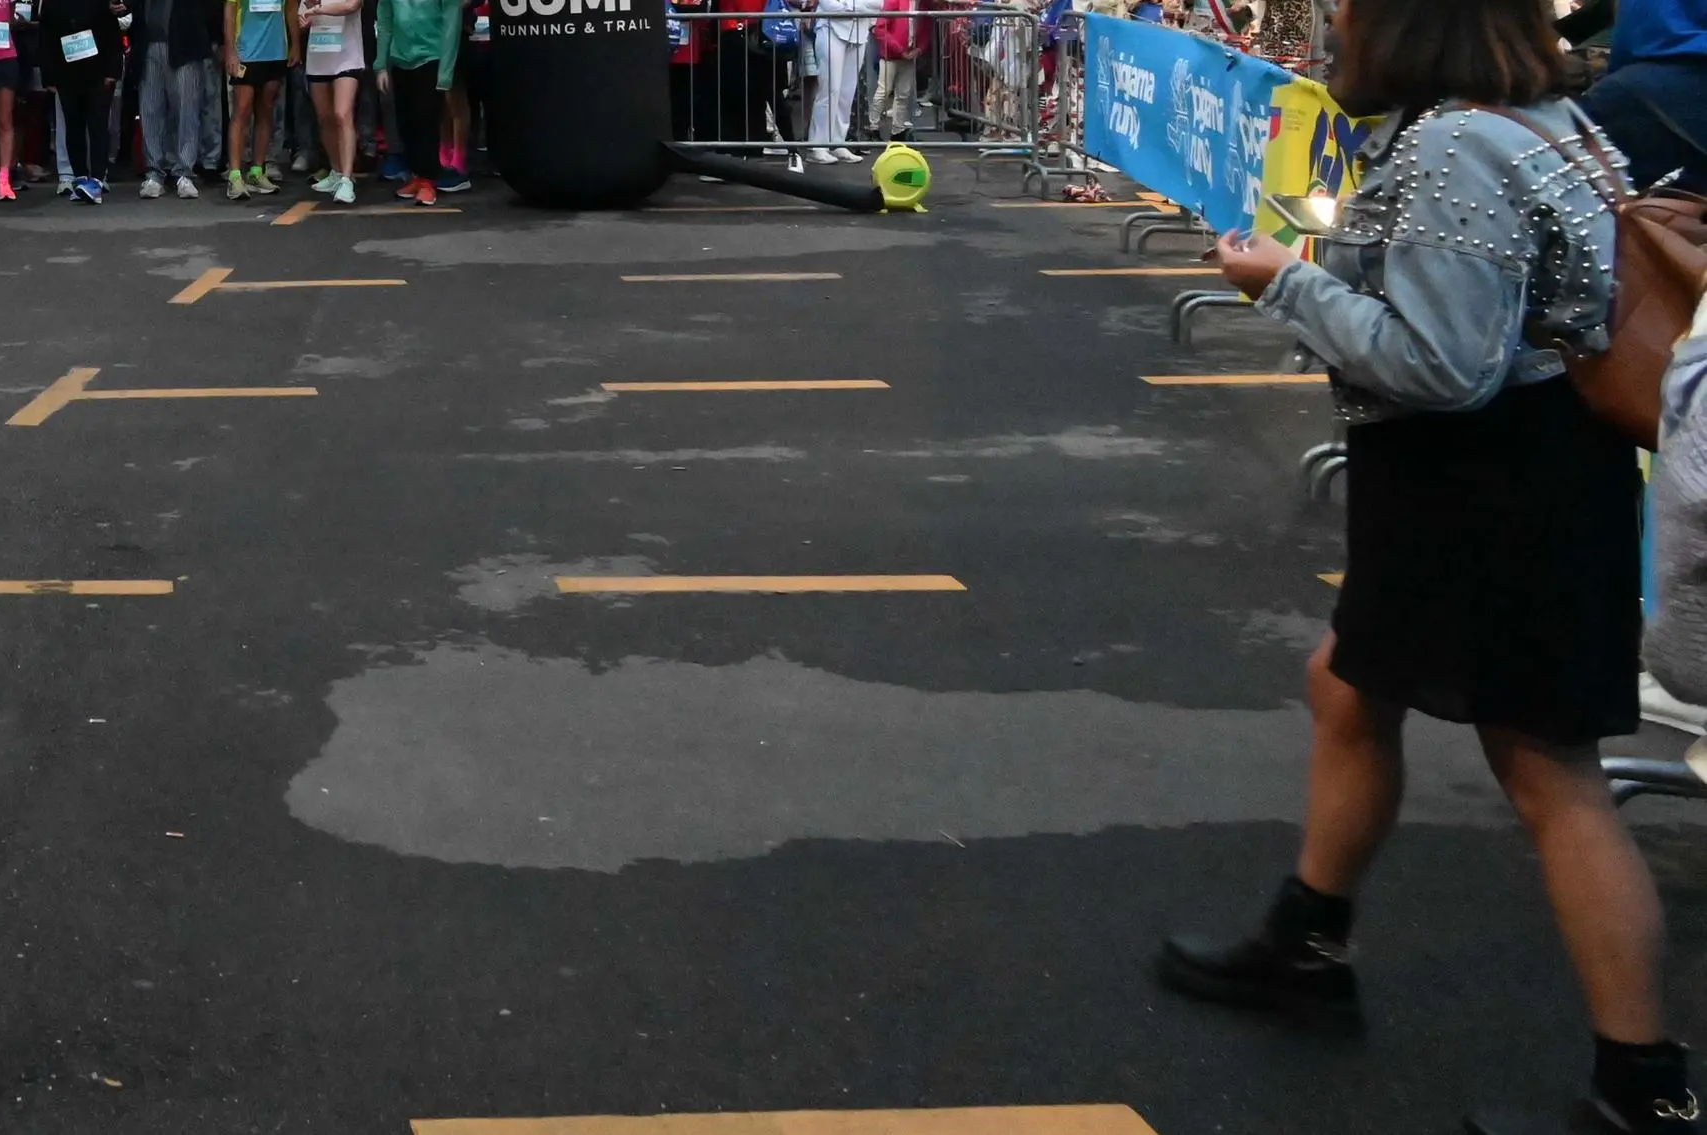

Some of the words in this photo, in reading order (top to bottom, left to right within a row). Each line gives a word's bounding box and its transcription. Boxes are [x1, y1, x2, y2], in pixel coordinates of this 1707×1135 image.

[500, 22, 576, 36] RUNNING
[584, 21, 596, 34] &
[603, 18, 651, 32] TRAIL
